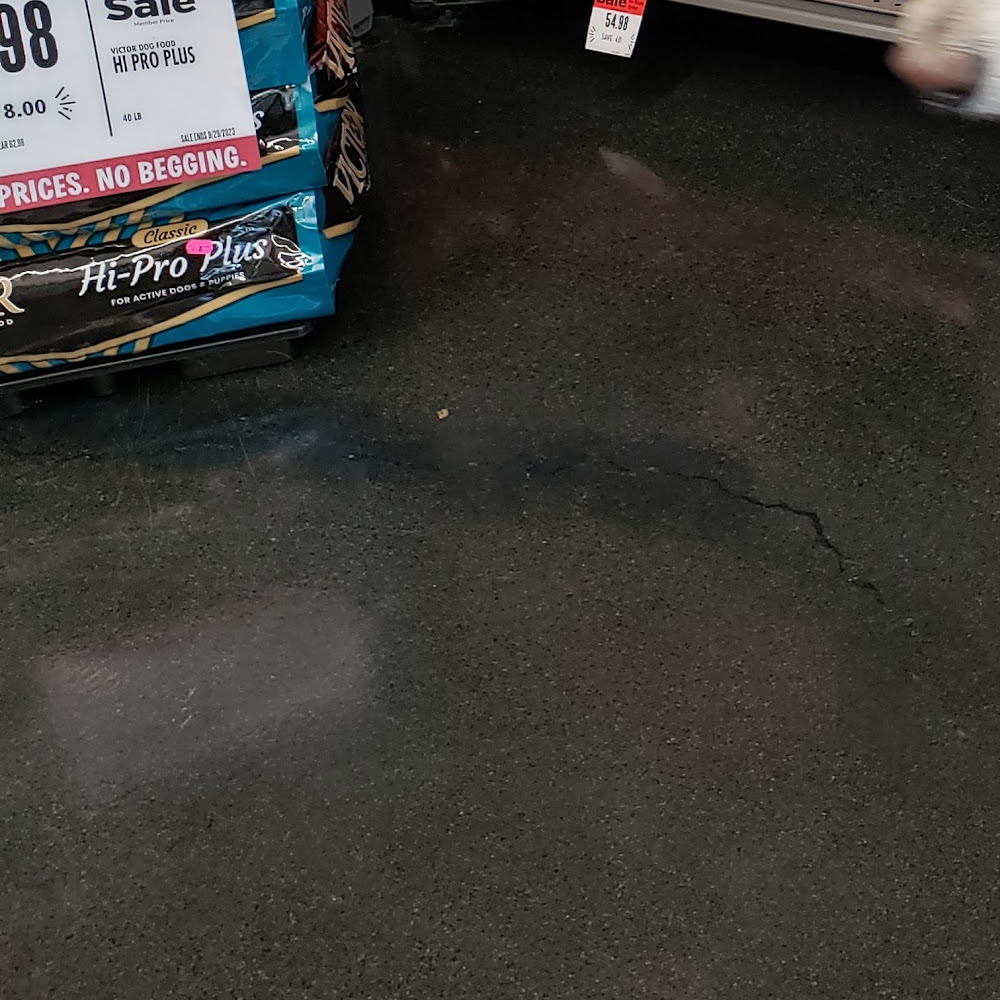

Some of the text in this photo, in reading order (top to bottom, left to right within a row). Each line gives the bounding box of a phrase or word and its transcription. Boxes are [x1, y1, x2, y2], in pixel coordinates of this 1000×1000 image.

[605, 13, 629, 30] 54.98
[111, 40, 176, 54] VICTOR DOG FOOD
[113, 47, 196, 73] HI PRO PLUS
[123, 112, 142, 122] 40 LB
[181, 133, 193, 143] SALE
[96, 146, 248, 191] NO BEGGING.
[144, 223, 198, 244] Classic
[78, 254, 188, 297] Hi-Pro
[111, 283, 198, 307] FOR ACTIVE DOGS
